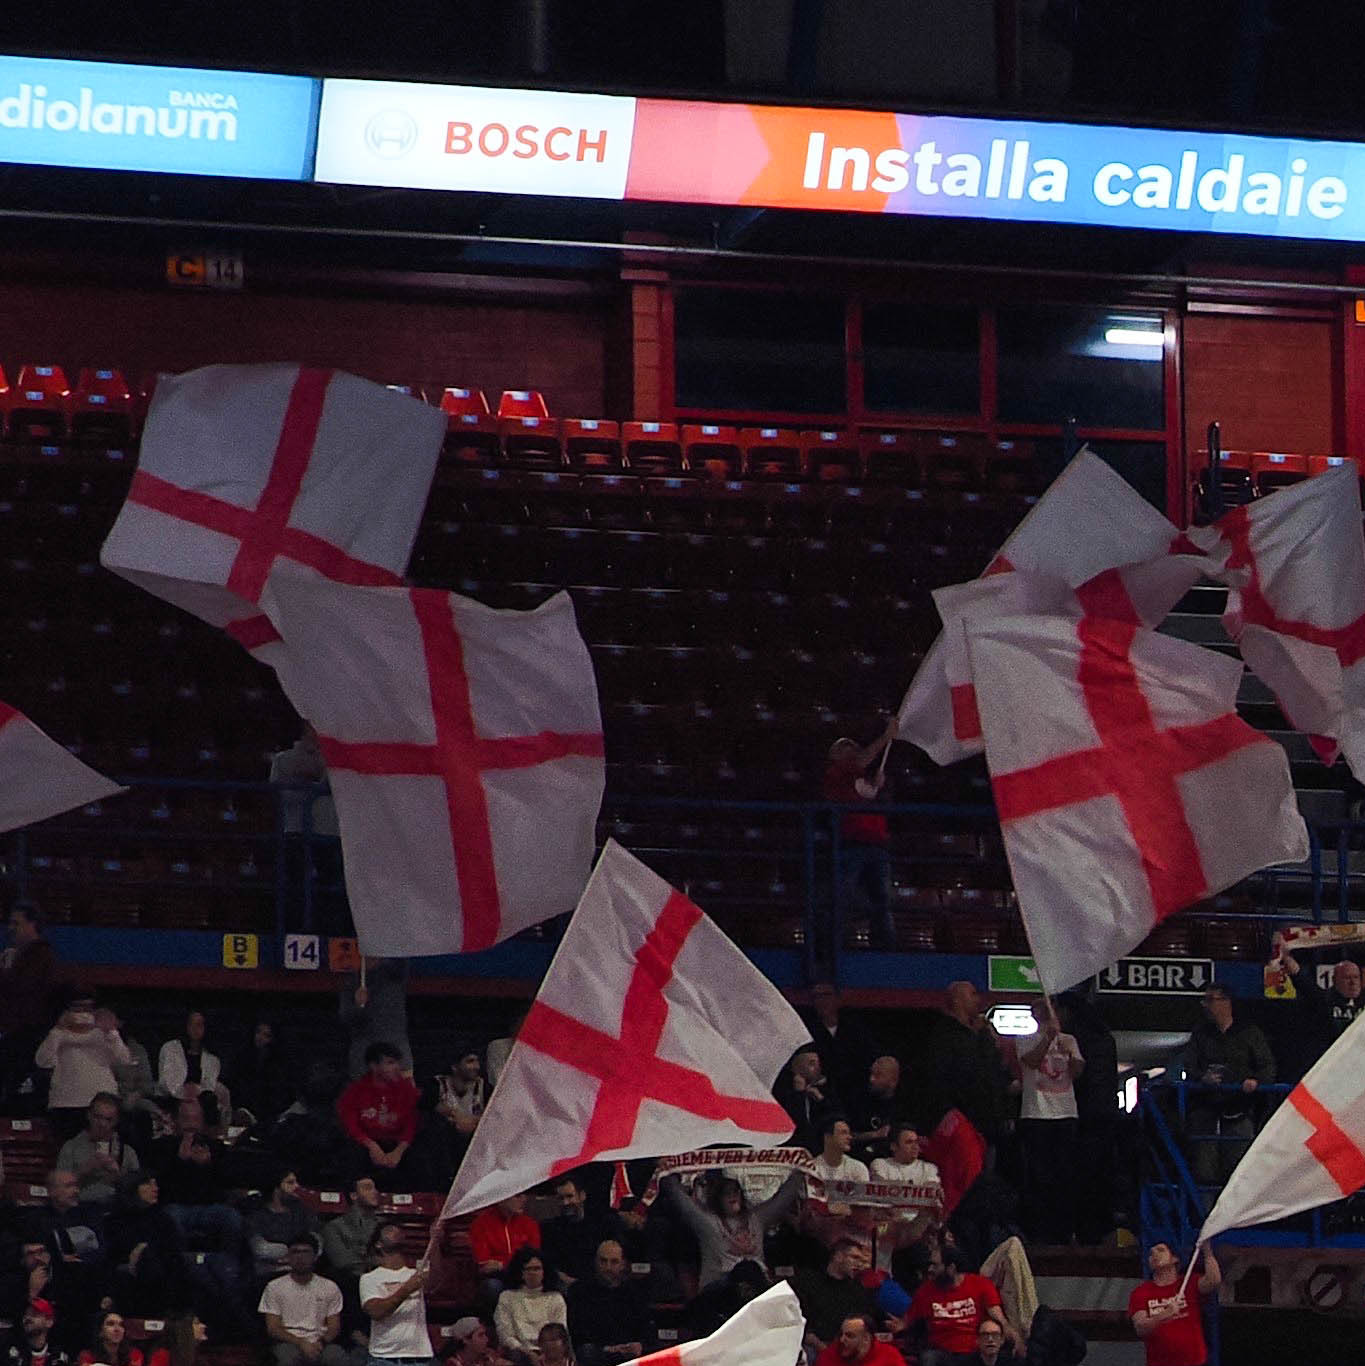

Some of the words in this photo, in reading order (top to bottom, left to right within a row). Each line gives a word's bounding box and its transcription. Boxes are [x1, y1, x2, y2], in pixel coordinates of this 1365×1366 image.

[168, 90, 239, 111] BANCA
[444, 121, 607, 163] BOSCH
[804, 132, 1069, 203] Installa
[1093, 152, 1346, 219] caldaie
[233, 936, 247, 953] B
[287, 940, 317, 963] 14
[1128, 964, 1186, 987] BAR
